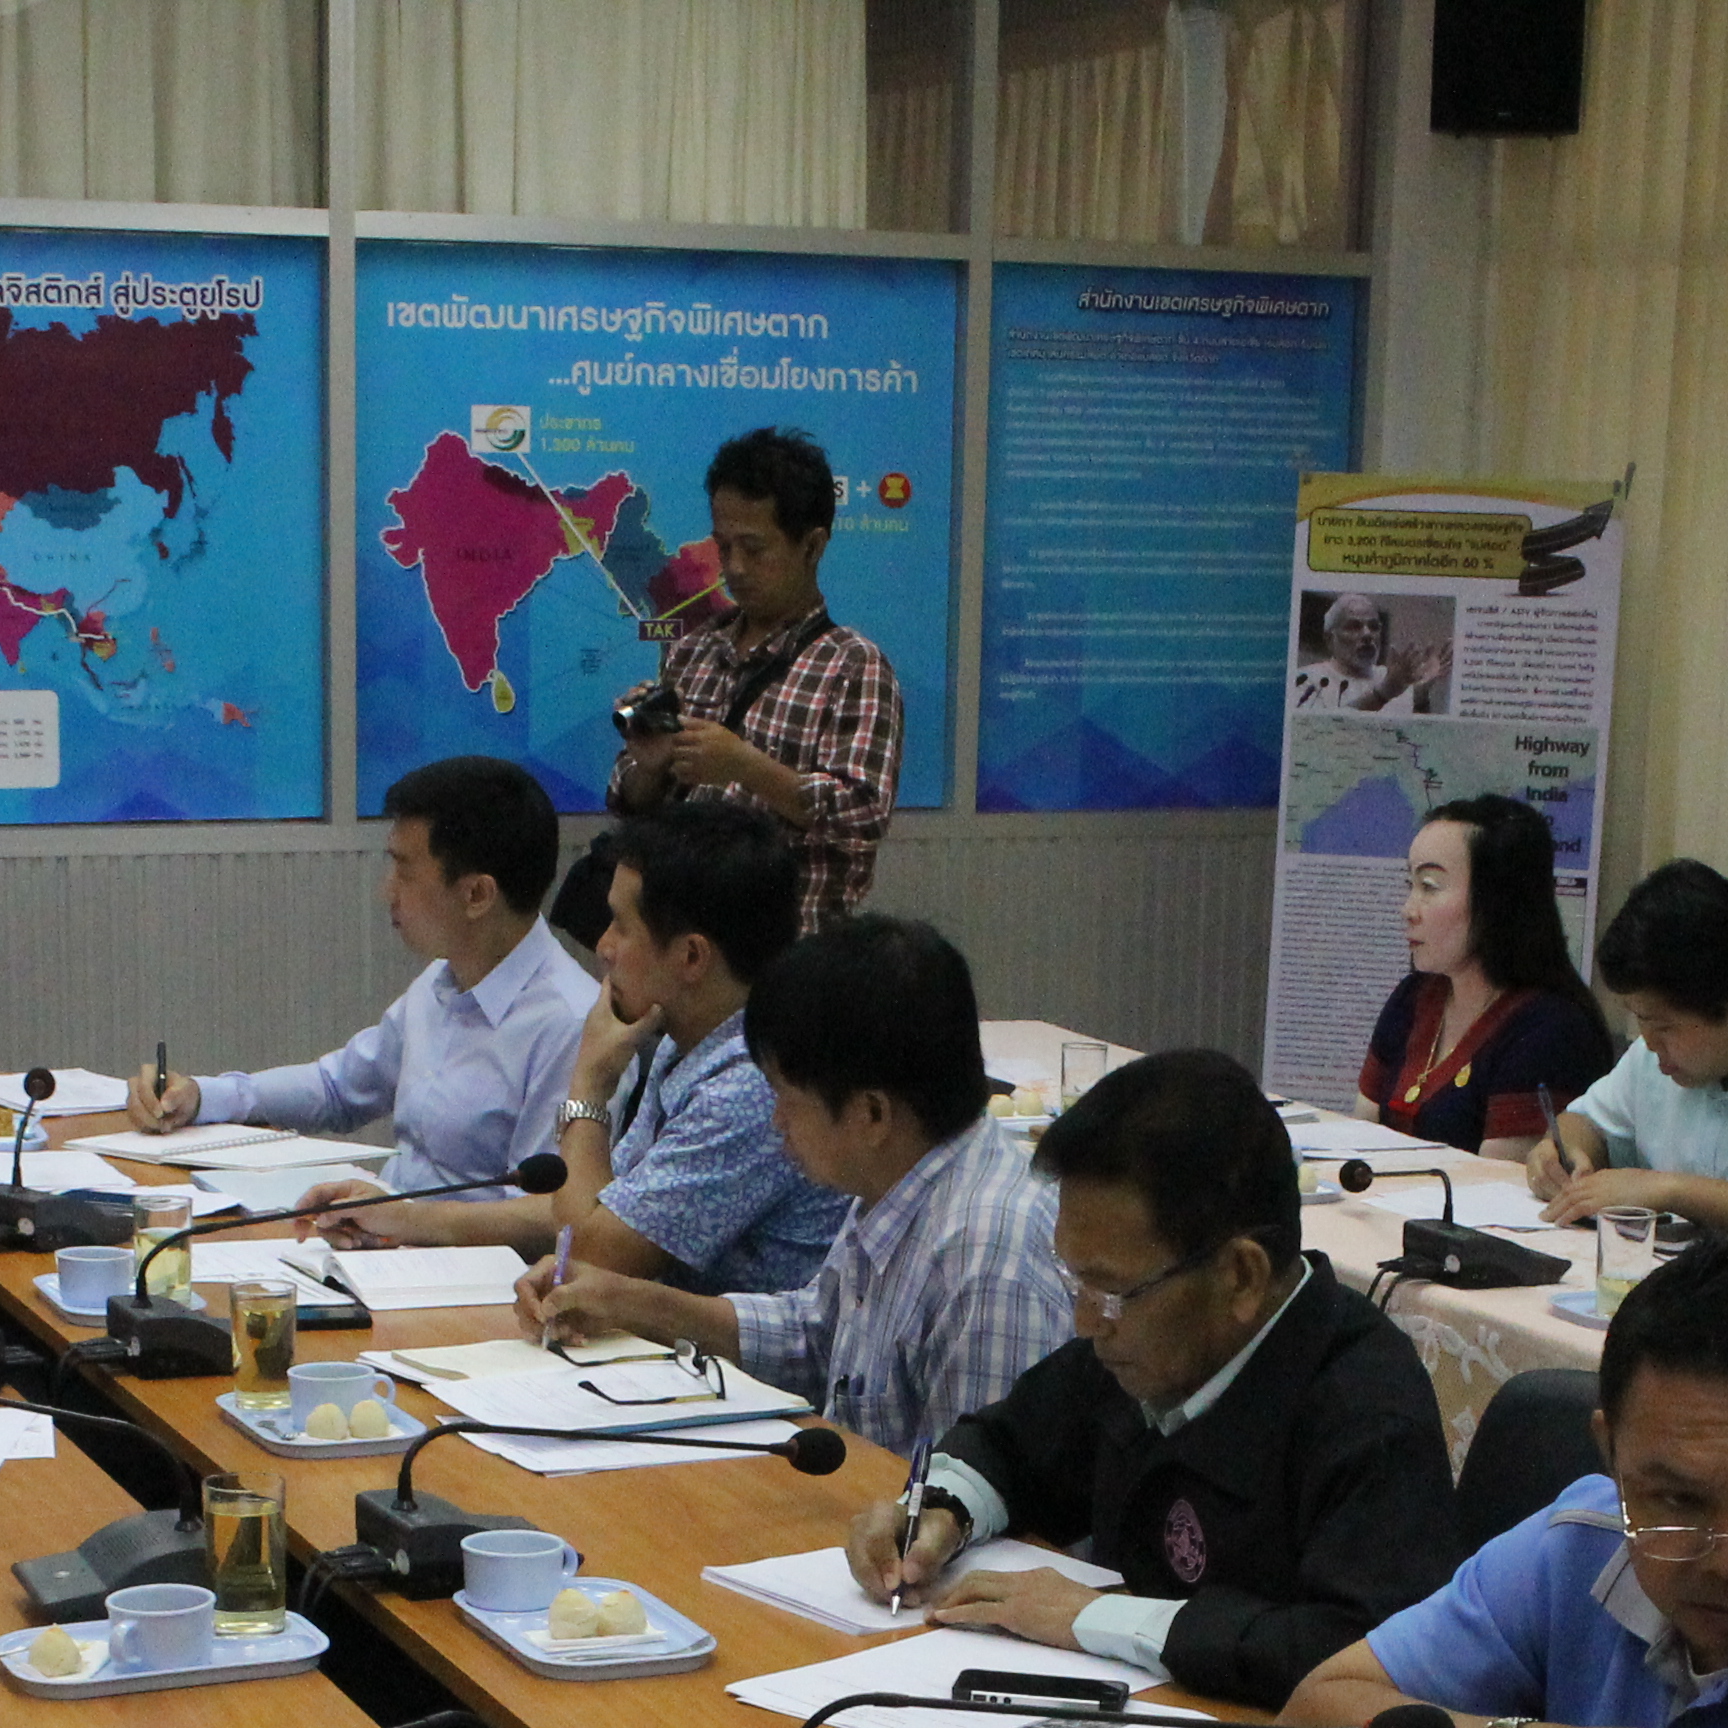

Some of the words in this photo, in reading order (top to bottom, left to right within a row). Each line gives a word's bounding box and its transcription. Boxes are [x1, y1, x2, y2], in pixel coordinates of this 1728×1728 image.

[110, 271, 264, 320] สู่ประตูยุโรป
[386, 293, 829, 342] เขตพัฒนาเศรษฐกิจพิเศษตาก
[644, 622, 675, 638] TAK
[1515, 735, 1590, 757] Highway
[1528, 760, 1569, 778] from
[1526, 786, 1569, 803] India
